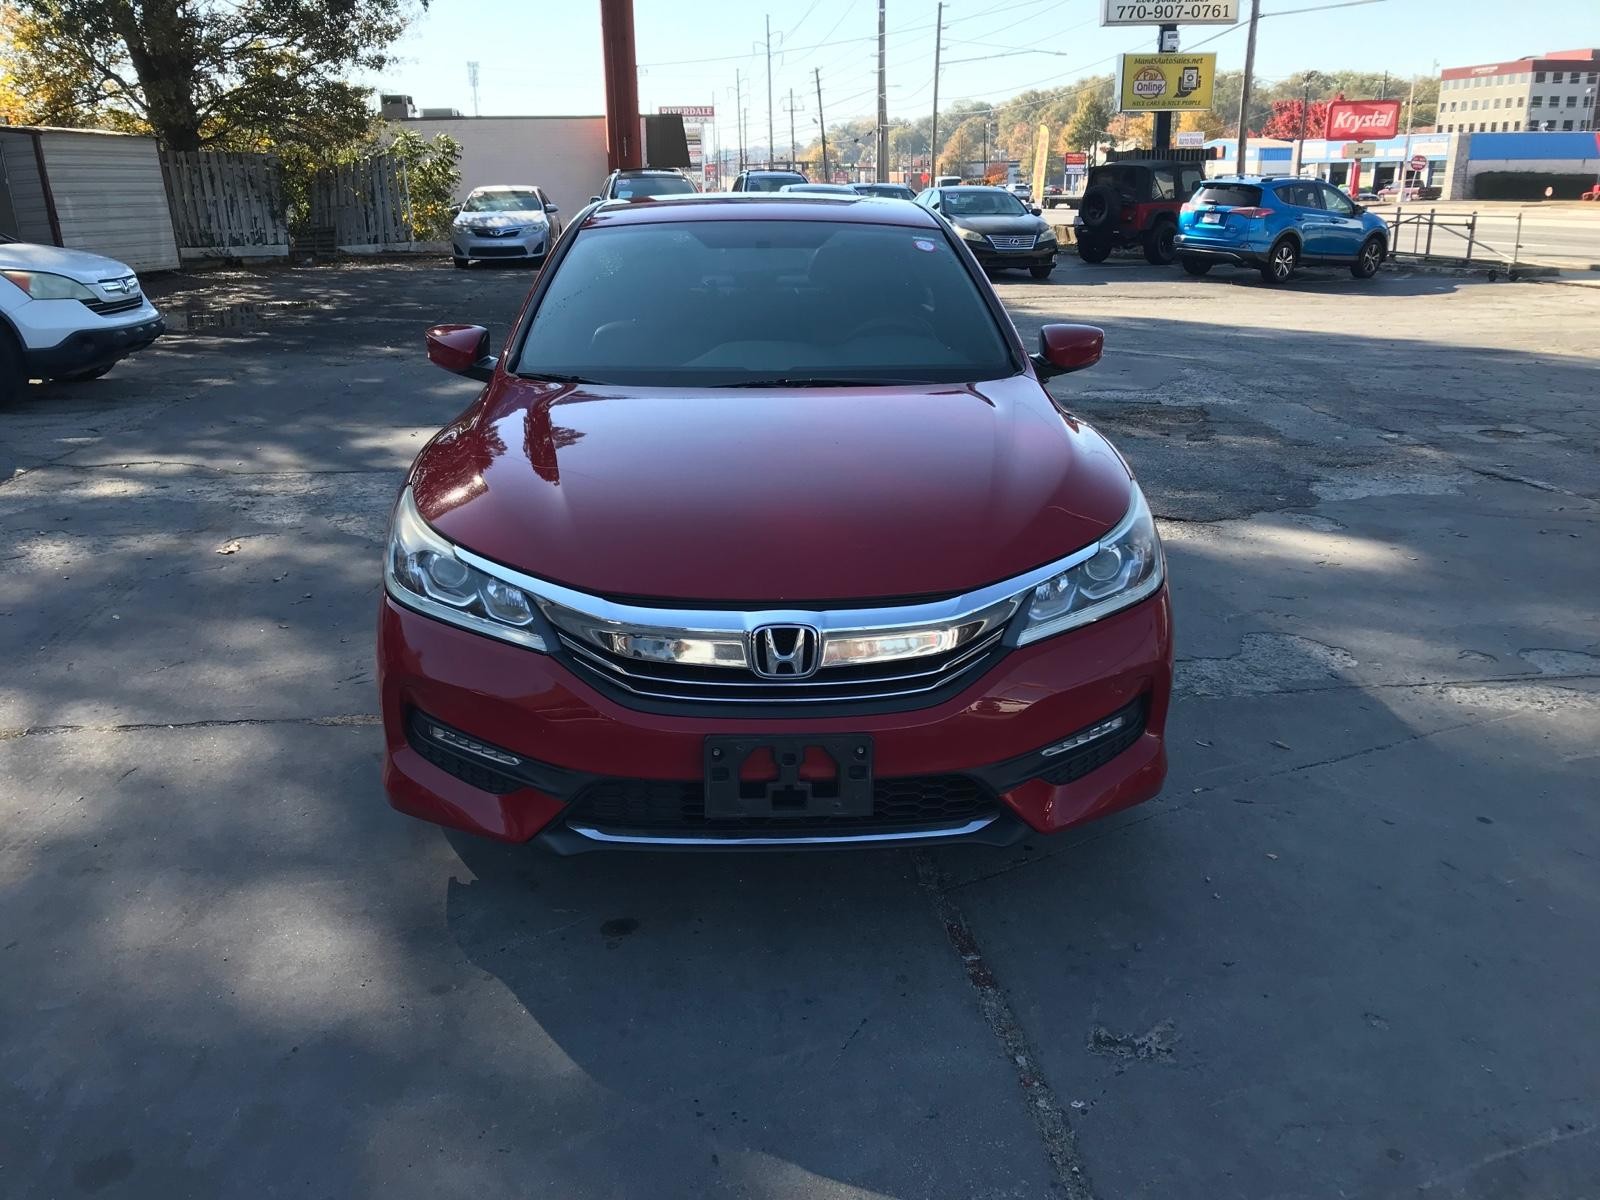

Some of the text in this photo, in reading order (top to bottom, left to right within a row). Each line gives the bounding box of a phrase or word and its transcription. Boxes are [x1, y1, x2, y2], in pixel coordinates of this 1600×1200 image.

[1116, 4, 1230, 19] 770-907-0761
[1143, 71, 1159, 81] Pay
[1136, 82, 1164, 92] Online
[661, 107, 712, 115] RIVERDALE
[1334, 111, 1394, 133] Krystal
